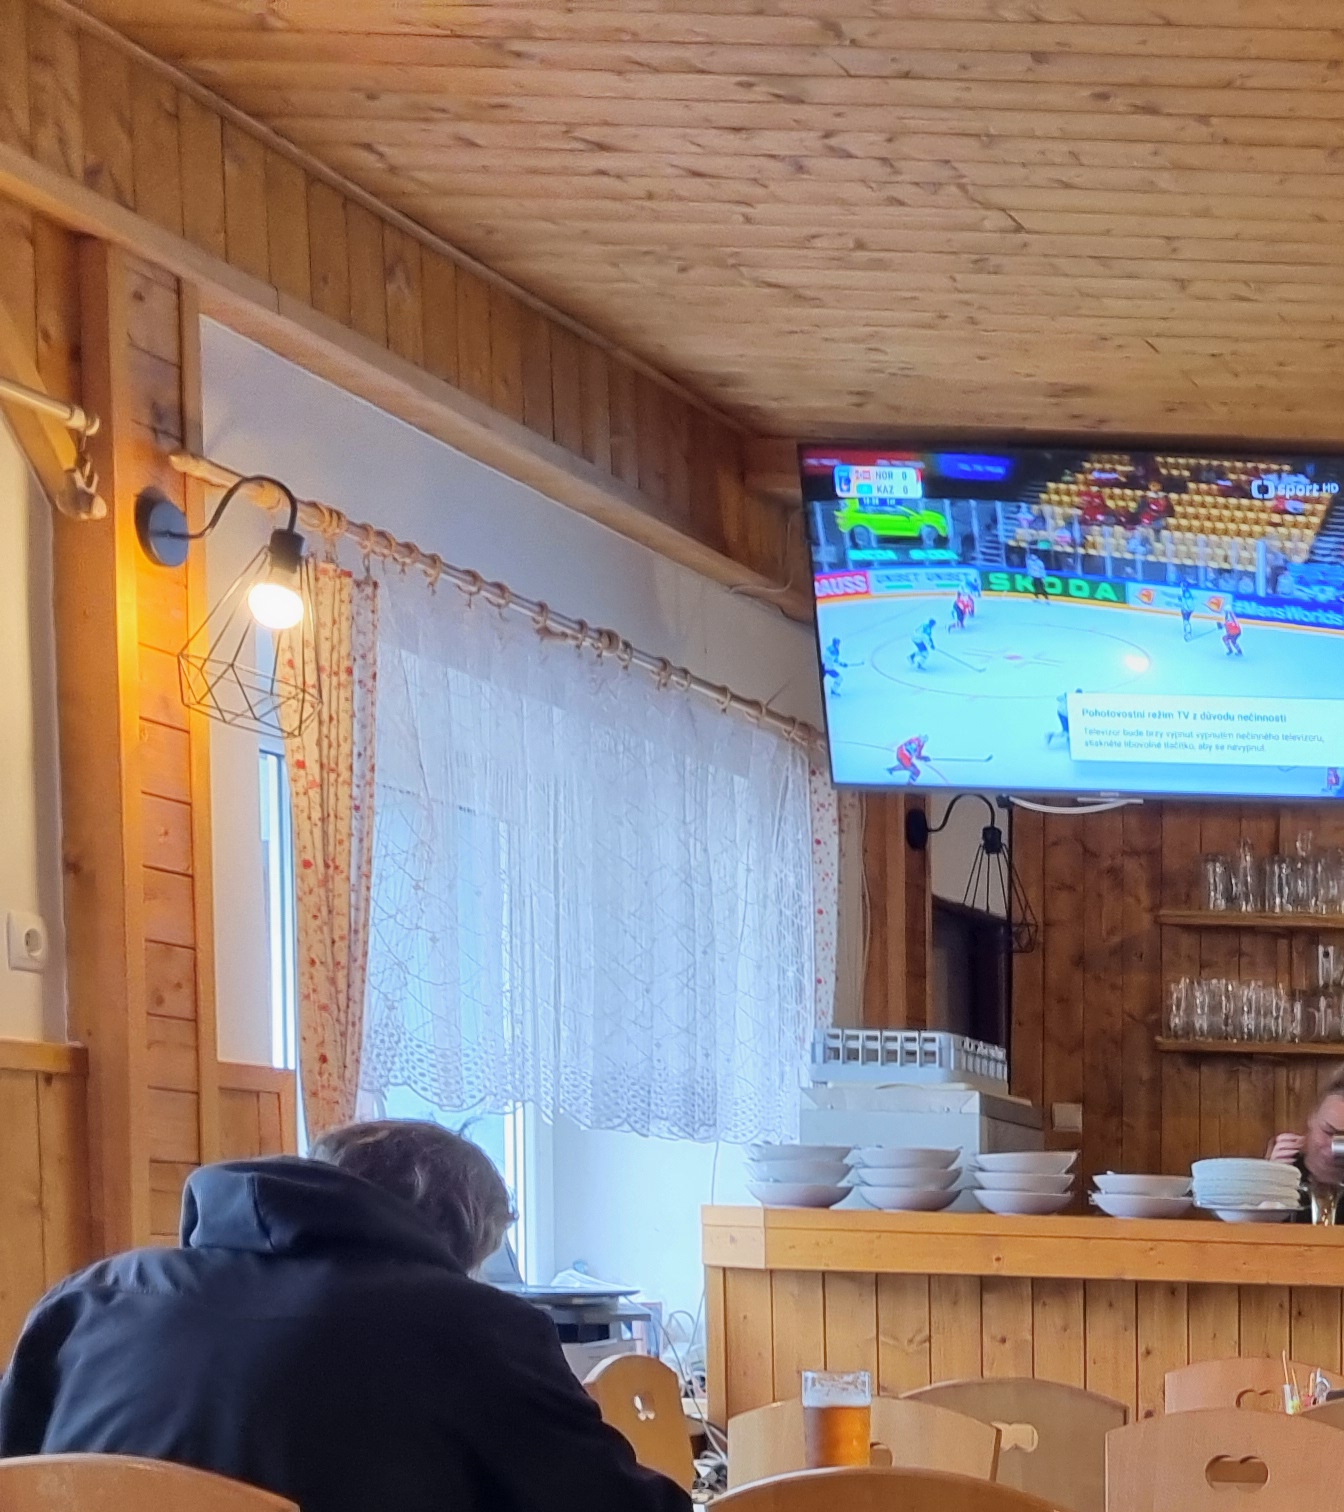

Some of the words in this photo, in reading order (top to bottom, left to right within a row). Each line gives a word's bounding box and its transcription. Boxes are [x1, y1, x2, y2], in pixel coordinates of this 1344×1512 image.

[875, 469, 894, 480] NOR
[877, 485, 895, 495] KAZ
[1277, 483, 1320, 499] sport
[1322, 483, 1340, 494] HD
[815, 575, 867, 597] AUSS
[1177, 711, 1190, 720] TV
